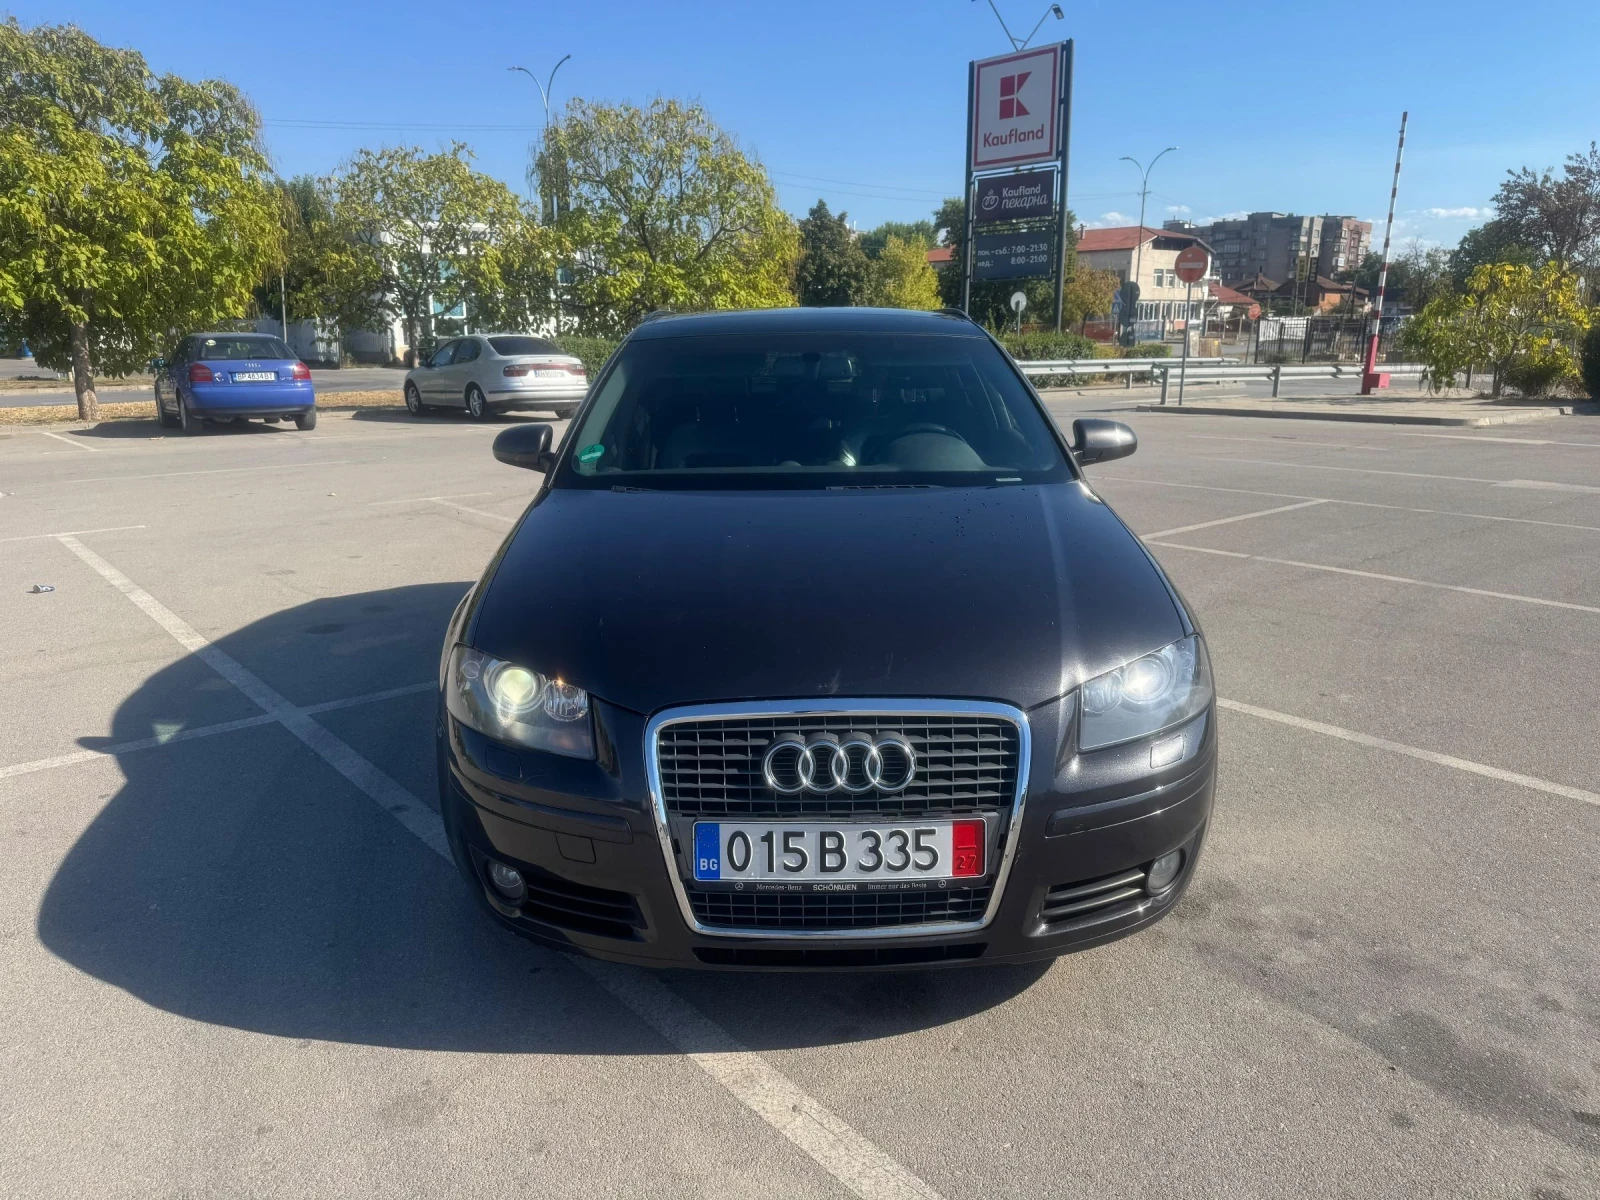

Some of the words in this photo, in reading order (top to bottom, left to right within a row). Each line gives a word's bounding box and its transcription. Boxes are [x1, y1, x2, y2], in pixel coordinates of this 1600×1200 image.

[983, 124, 1044, 148] Kaufland
[1002, 184, 1041, 198] Kaufland
[1001, 194, 1048, 210] пекарна
[727, 830, 809, 873] 015
[819, 830, 848, 873] B
[858, 827, 939, 872] 335
[700, 858, 718, 871] BG
[956, 854, 977, 870] 27
